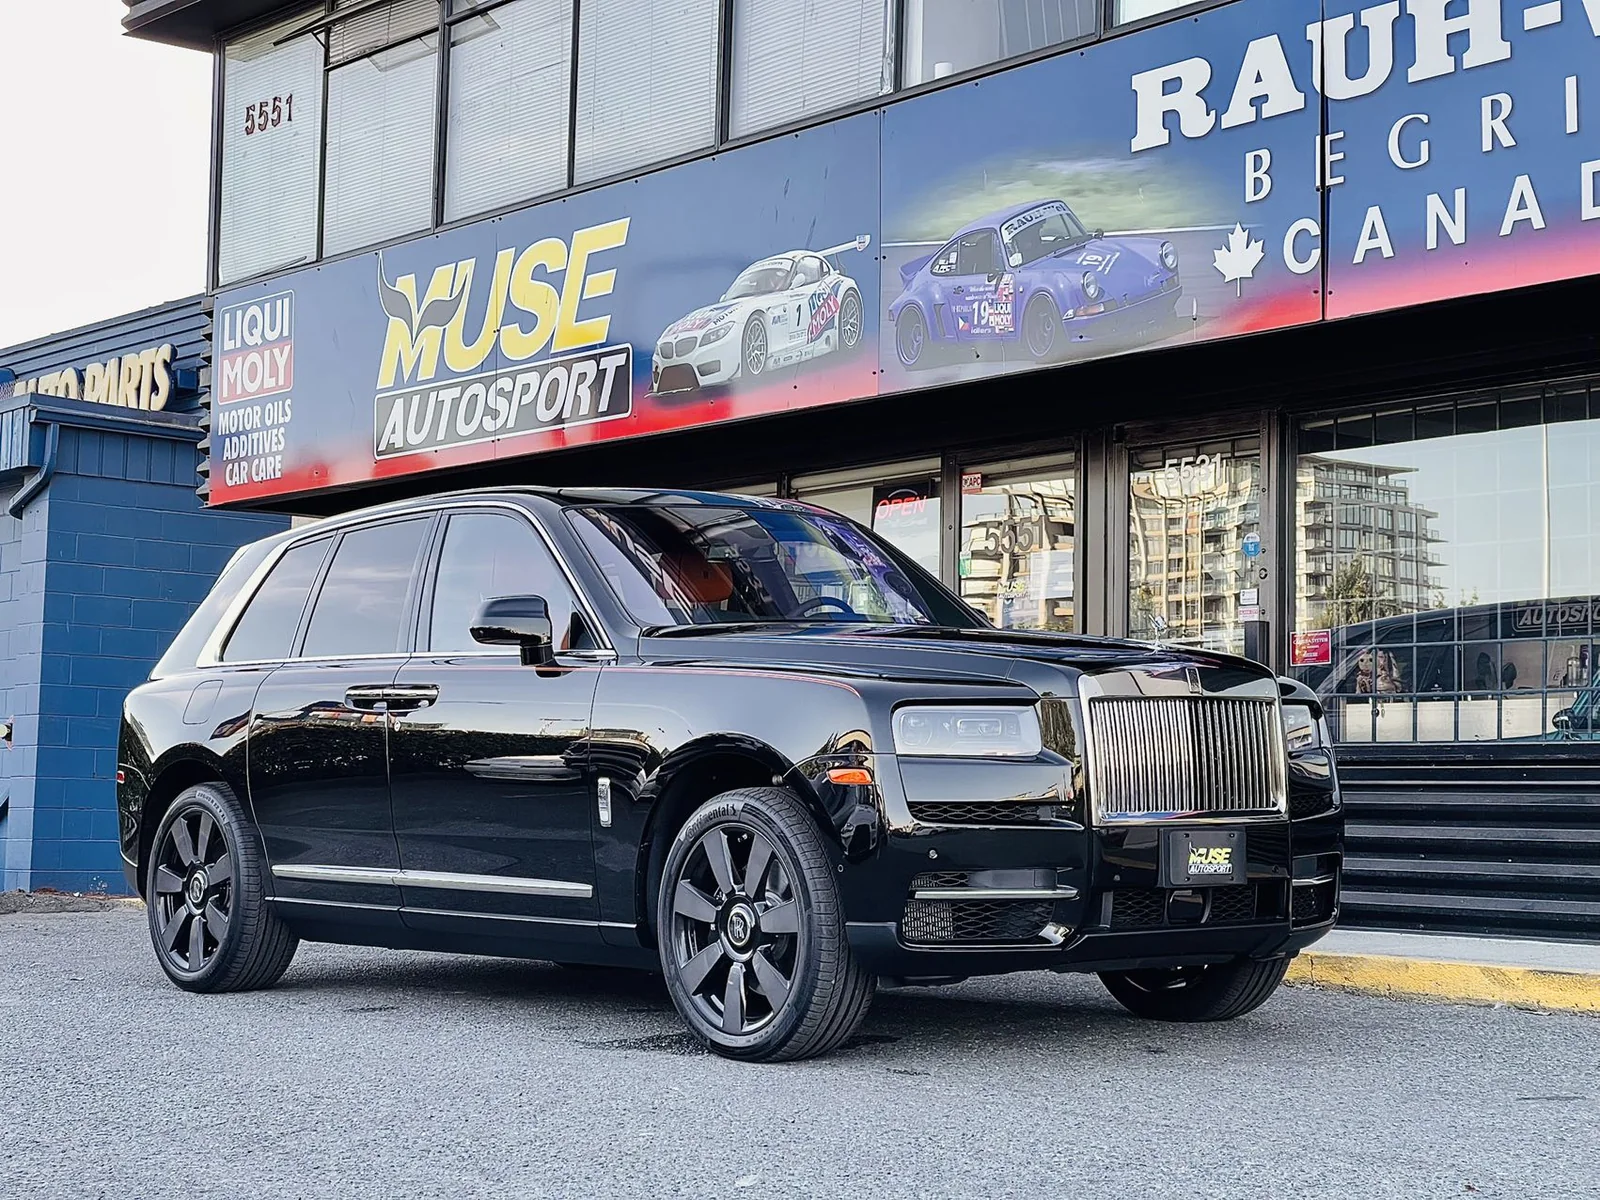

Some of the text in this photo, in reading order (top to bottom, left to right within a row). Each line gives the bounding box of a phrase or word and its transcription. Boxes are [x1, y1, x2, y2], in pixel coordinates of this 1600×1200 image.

[1131, 0, 1600, 152] RAUH-
[245, 93, 293, 136] 5551
[376, 217, 631, 390] MUSE
[796, 303, 802, 327] 1
[972, 300, 989, 326] 19
[223, 297, 290, 351] LIQUI
[222, 344, 291, 398] MOLY
[218, 398, 292, 436] MOTOR OILS
[377, 353, 628, 452] AUTOSPORT
[223, 427, 286, 461] ADDITIVES
[225, 455, 283, 488] CAR CARE
[874, 495, 927, 520] OPEN
[984, 515, 1044, 556] 5551
[1188, 845, 1232, 864] MUSE
[1189, 863, 1232, 873] AUTOSPORT
